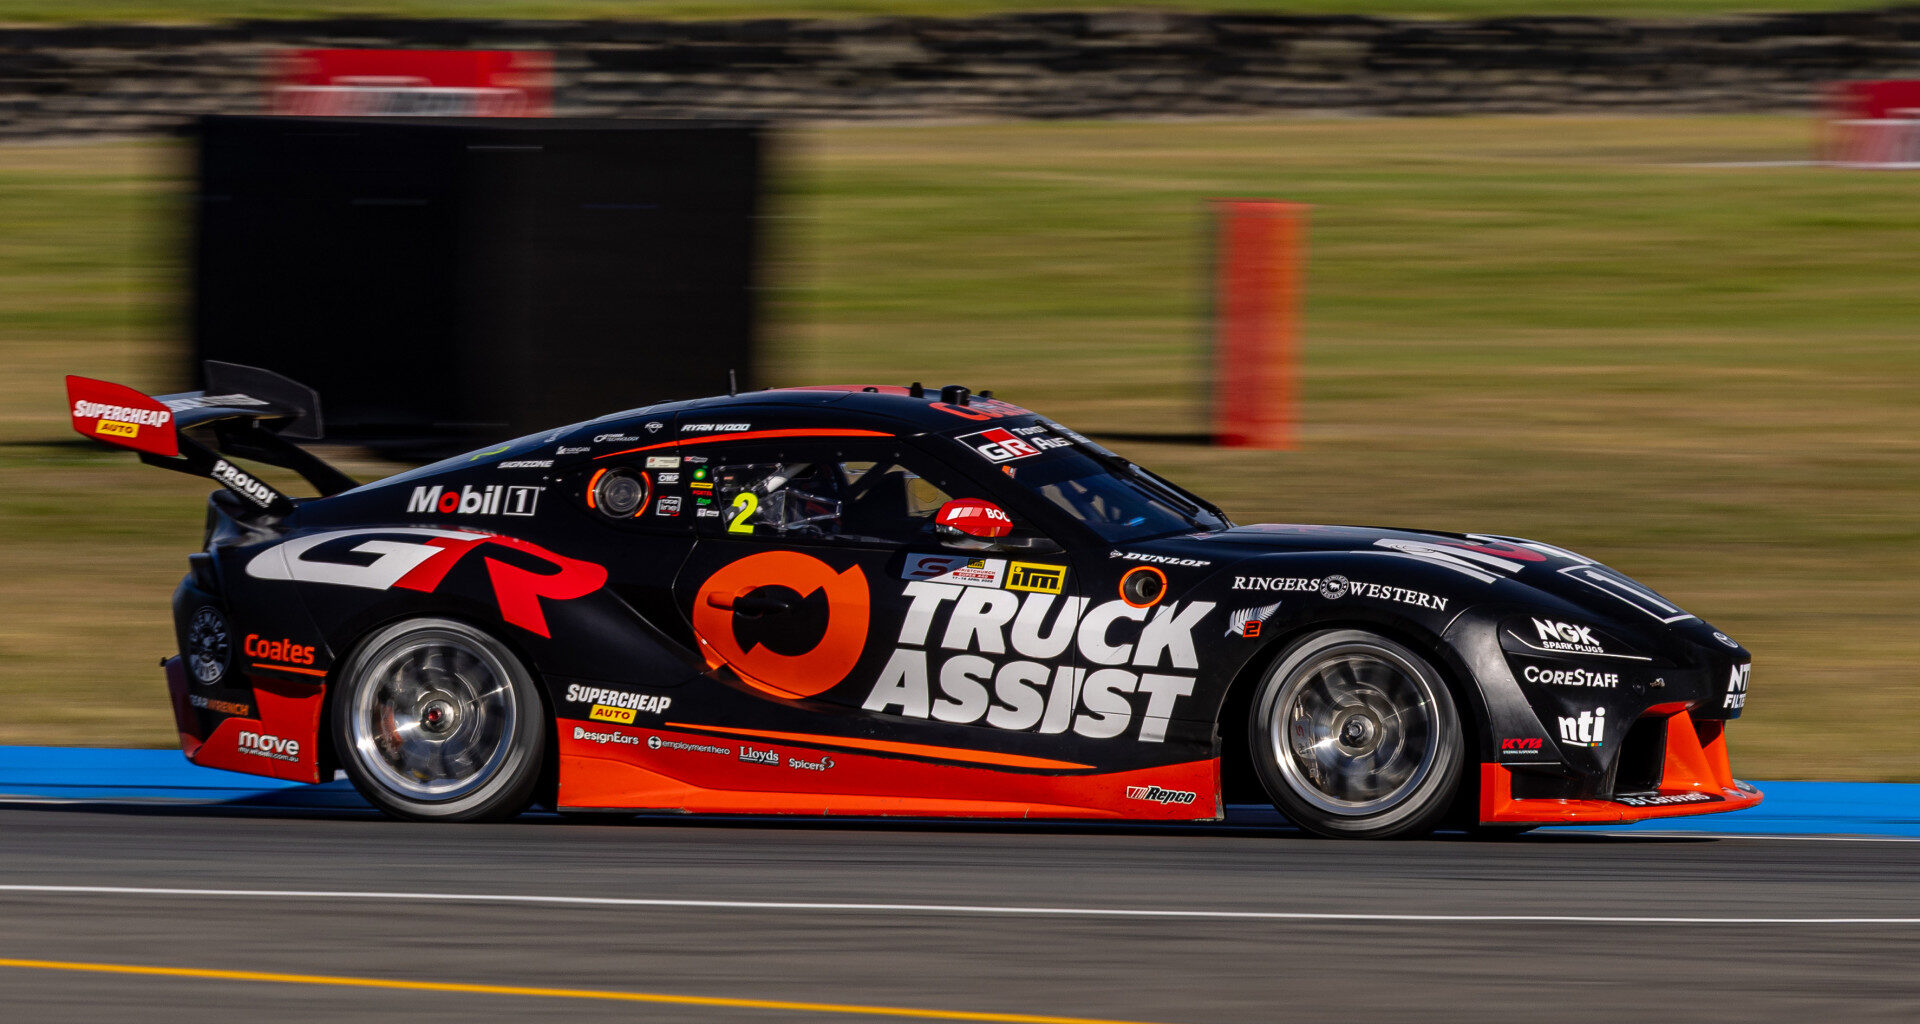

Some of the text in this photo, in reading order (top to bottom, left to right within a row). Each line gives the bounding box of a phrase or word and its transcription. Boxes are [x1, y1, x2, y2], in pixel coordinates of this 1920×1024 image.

[73, 400, 171, 428] SUPERCHEAP
[100, 422, 134, 435] AUTO
[681, 423, 751, 432] RYAN WOOD
[977, 438, 1038, 461] GR
[658, 473, 680, 482] OMP
[406, 485, 503, 515] Mobil
[728, 492, 758, 534] 2
[1122, 551, 1211, 567] DUNLOP
[245, 526, 608, 639] GR
[1232, 576, 1320, 592] RINGERS
[1349, 580, 1449, 612] WESTERN
[898, 580, 1217, 670] TRUCK
[1531, 617, 1600, 647] NGK
[243, 634, 316, 665] Coates
[1542, 641, 1604, 654] SPARK PLUGS
[565, 683, 672, 714] SUPERCHEAP
[861, 648, 1197, 743] ASSIST
[594, 708, 631, 720] AUTO
[1558, 707, 1606, 742] nti
[237, 730, 300, 756] move
[573, 726, 640, 745] DesignEars
[1501, 738, 1543, 749] KYB
[739, 745, 779, 763] Lloyds
[788, 757, 825, 772] Spicers
[1145, 785, 1197, 805] Repco
